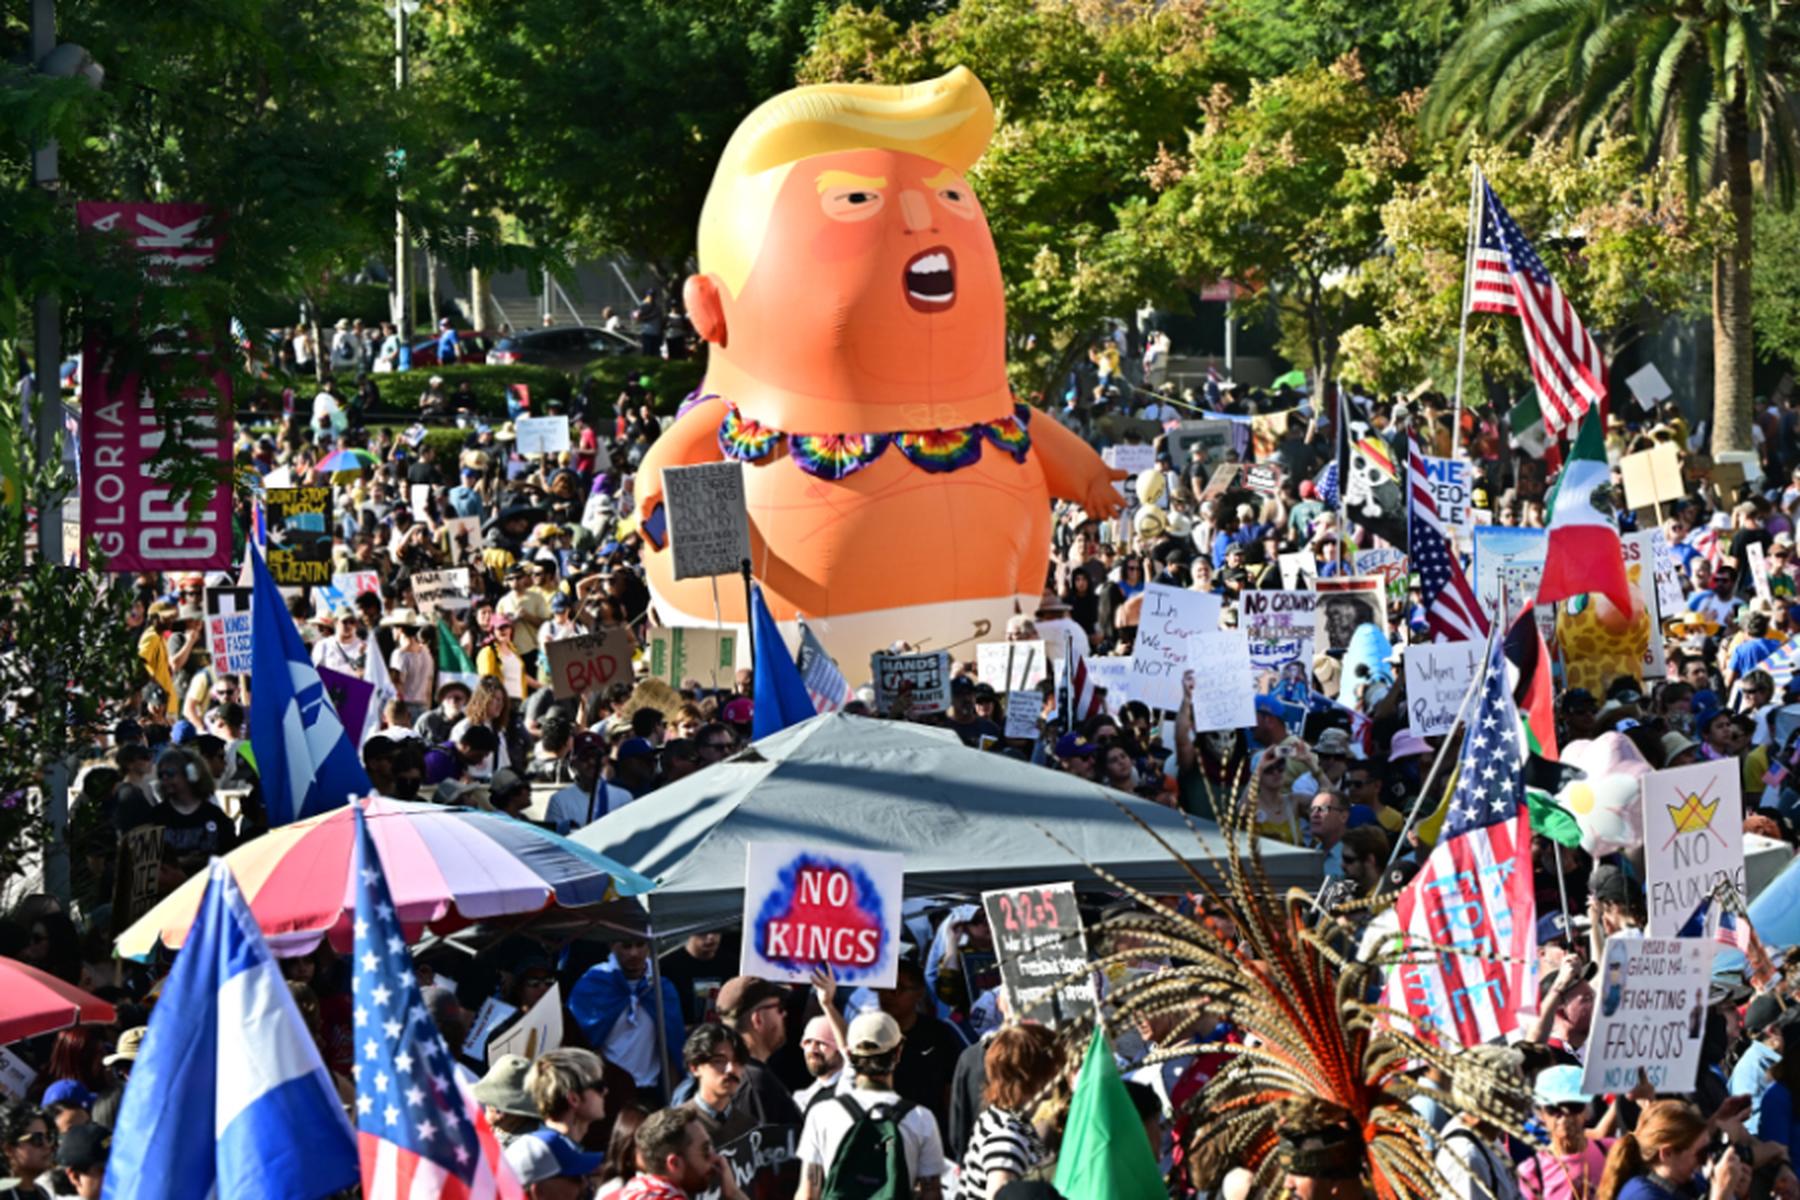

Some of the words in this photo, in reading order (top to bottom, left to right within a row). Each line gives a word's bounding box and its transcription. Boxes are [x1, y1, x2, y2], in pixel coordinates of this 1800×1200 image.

[94, 402, 125, 558] GLORIA
[1423, 458, 1464, 485] WE
[1245, 592, 1268, 615] NO
[566, 653, 617, 694] BAD
[881, 658, 938, 672] HANDS
[1134, 659, 1177, 677] NOT
[1672, 831, 1710, 870] NO
[800, 871, 849, 907] NO
[1651, 876, 1704, 917] FAUX
[767, 920, 878, 964] KINGS
[1620, 989, 1687, 1011] FIGHTING
[1603, 1021, 1687, 1060] FASCISTS
[1604, 1066, 1621, 1088] NO
[1623, 1064, 1669, 1087] KIGS!
[749, 1130, 796, 1177] Peopl
